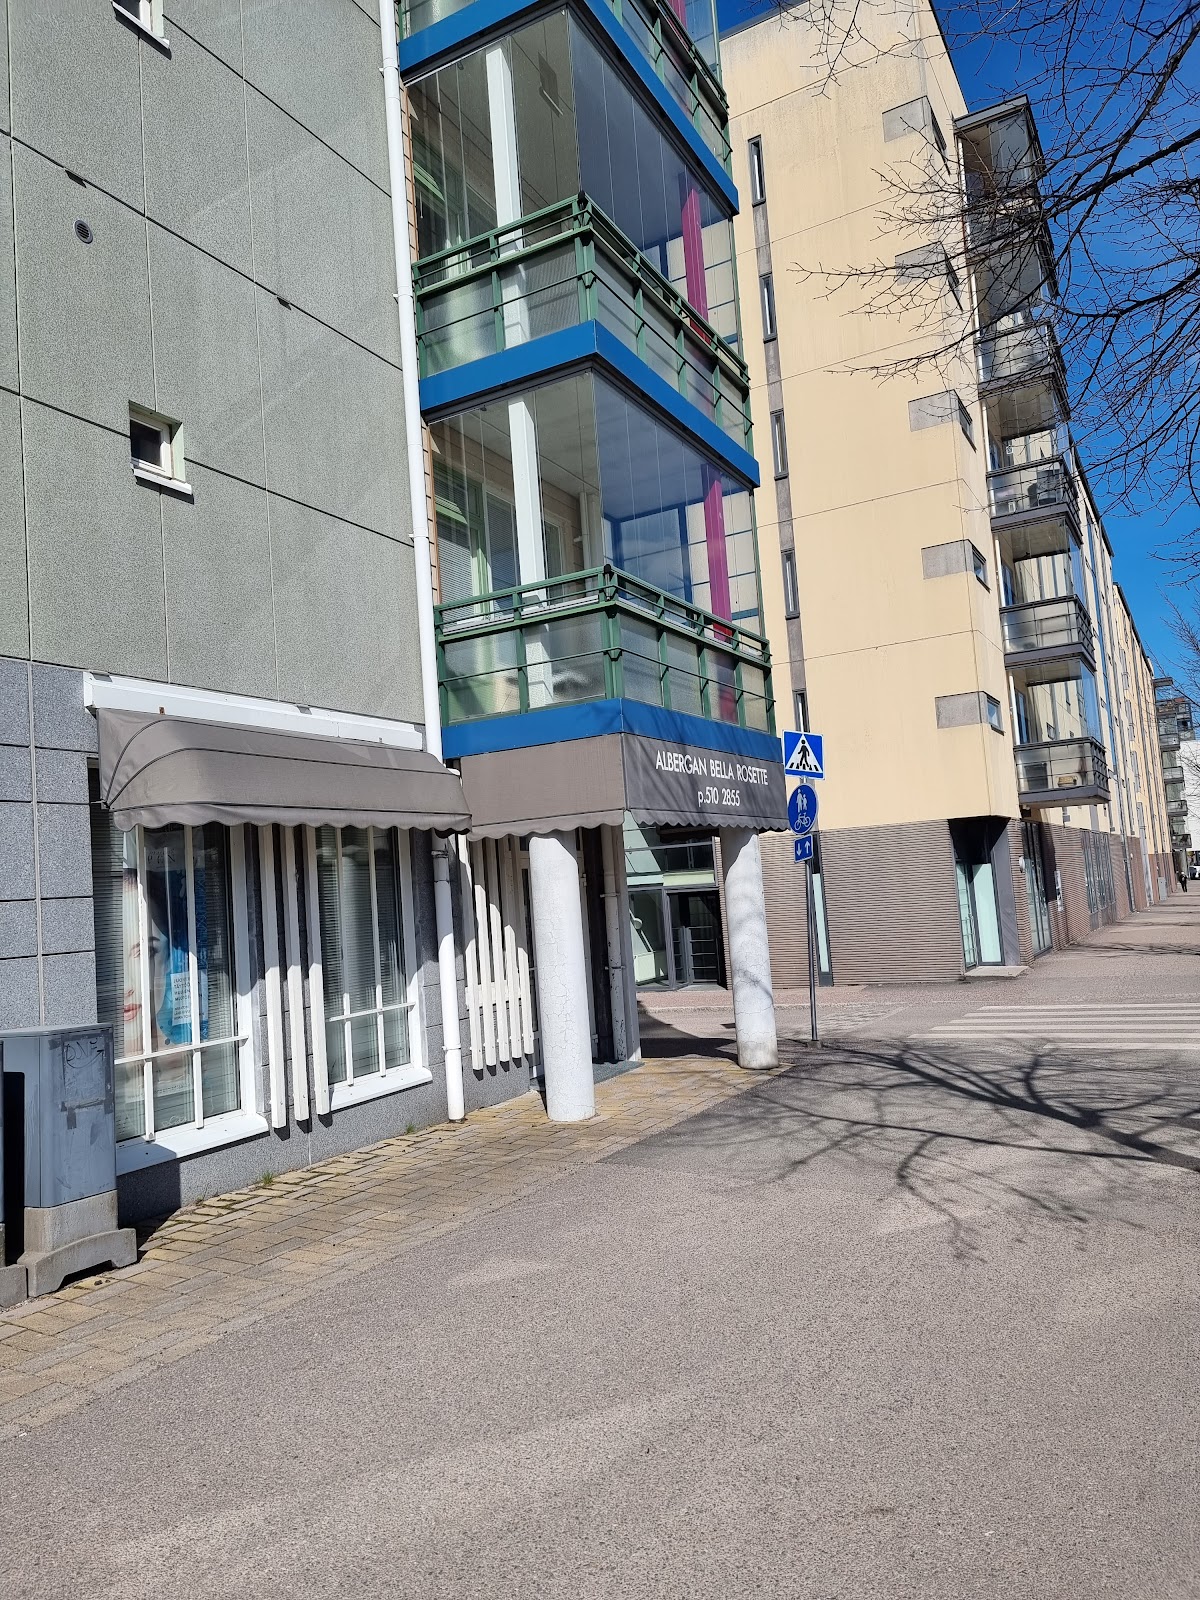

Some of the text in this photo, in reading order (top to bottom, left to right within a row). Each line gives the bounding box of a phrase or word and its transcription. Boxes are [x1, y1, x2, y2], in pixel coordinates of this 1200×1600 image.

[656, 750, 768, 785] ALBERGAN BELLA ROSETTE
[698, 786, 740, 807] p.510 2855
